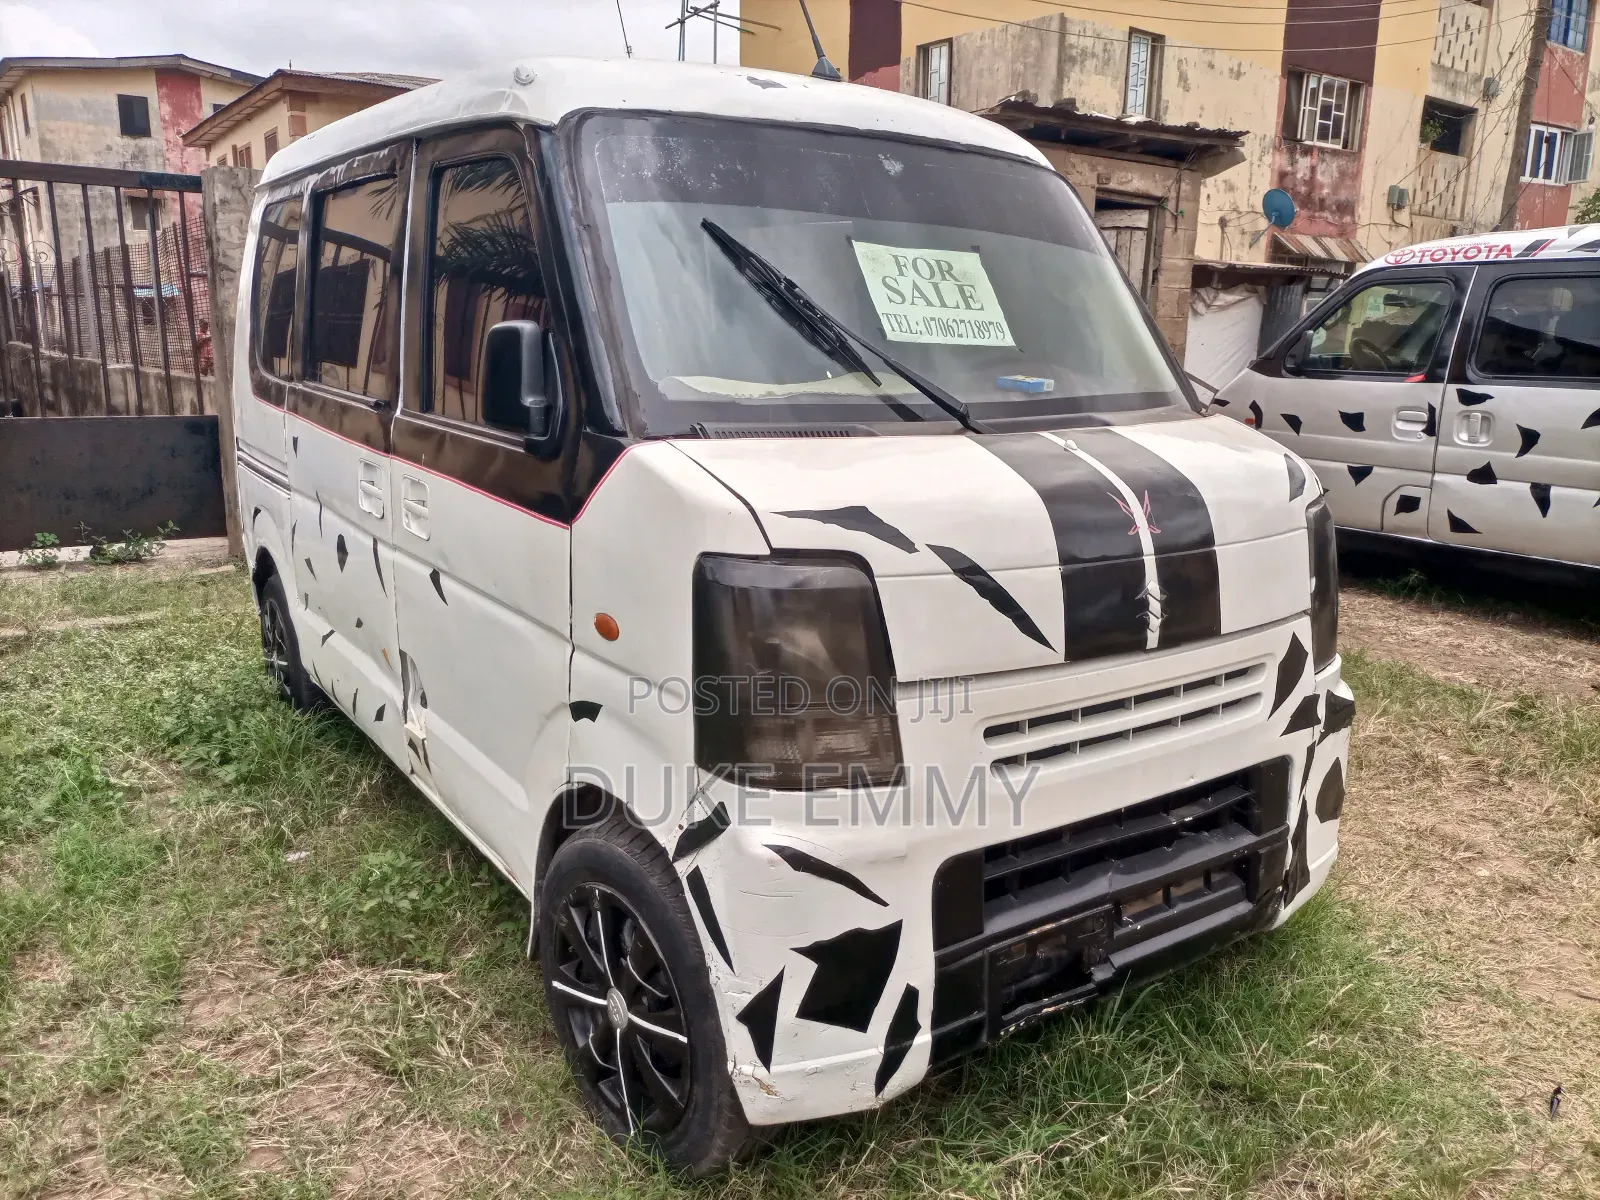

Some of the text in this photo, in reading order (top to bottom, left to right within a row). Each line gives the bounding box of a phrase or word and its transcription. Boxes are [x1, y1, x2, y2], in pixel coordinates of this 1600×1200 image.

[889, 253, 962, 283] FOR
[1418, 243, 1513, 264] TOYOTA
[881, 275, 985, 311] SALE
